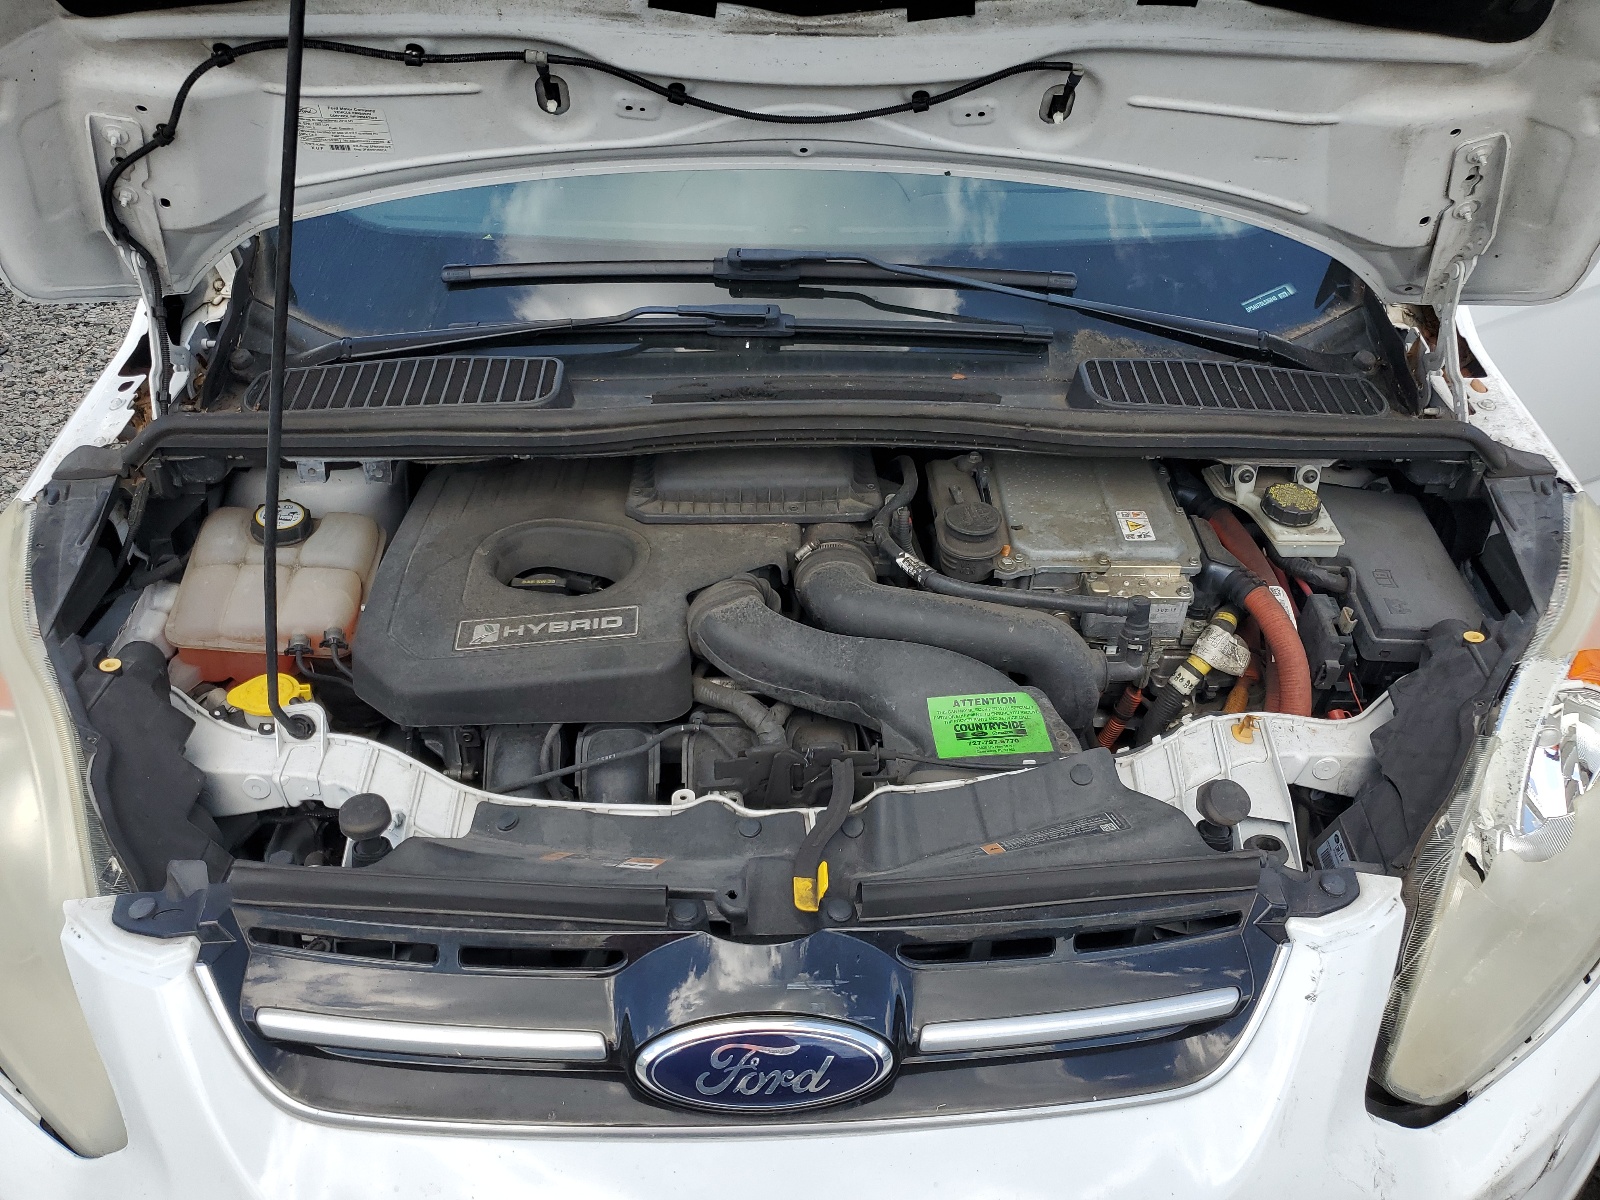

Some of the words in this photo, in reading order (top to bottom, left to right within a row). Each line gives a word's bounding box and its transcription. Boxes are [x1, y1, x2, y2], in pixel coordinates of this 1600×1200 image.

[503, 616, 623, 638] HYBRID
[952, 696, 1017, 708] ATTENTION
[953, 720, 1026, 733] COUNTRYSIDE
[695, 1043, 835, 1096] Ford
